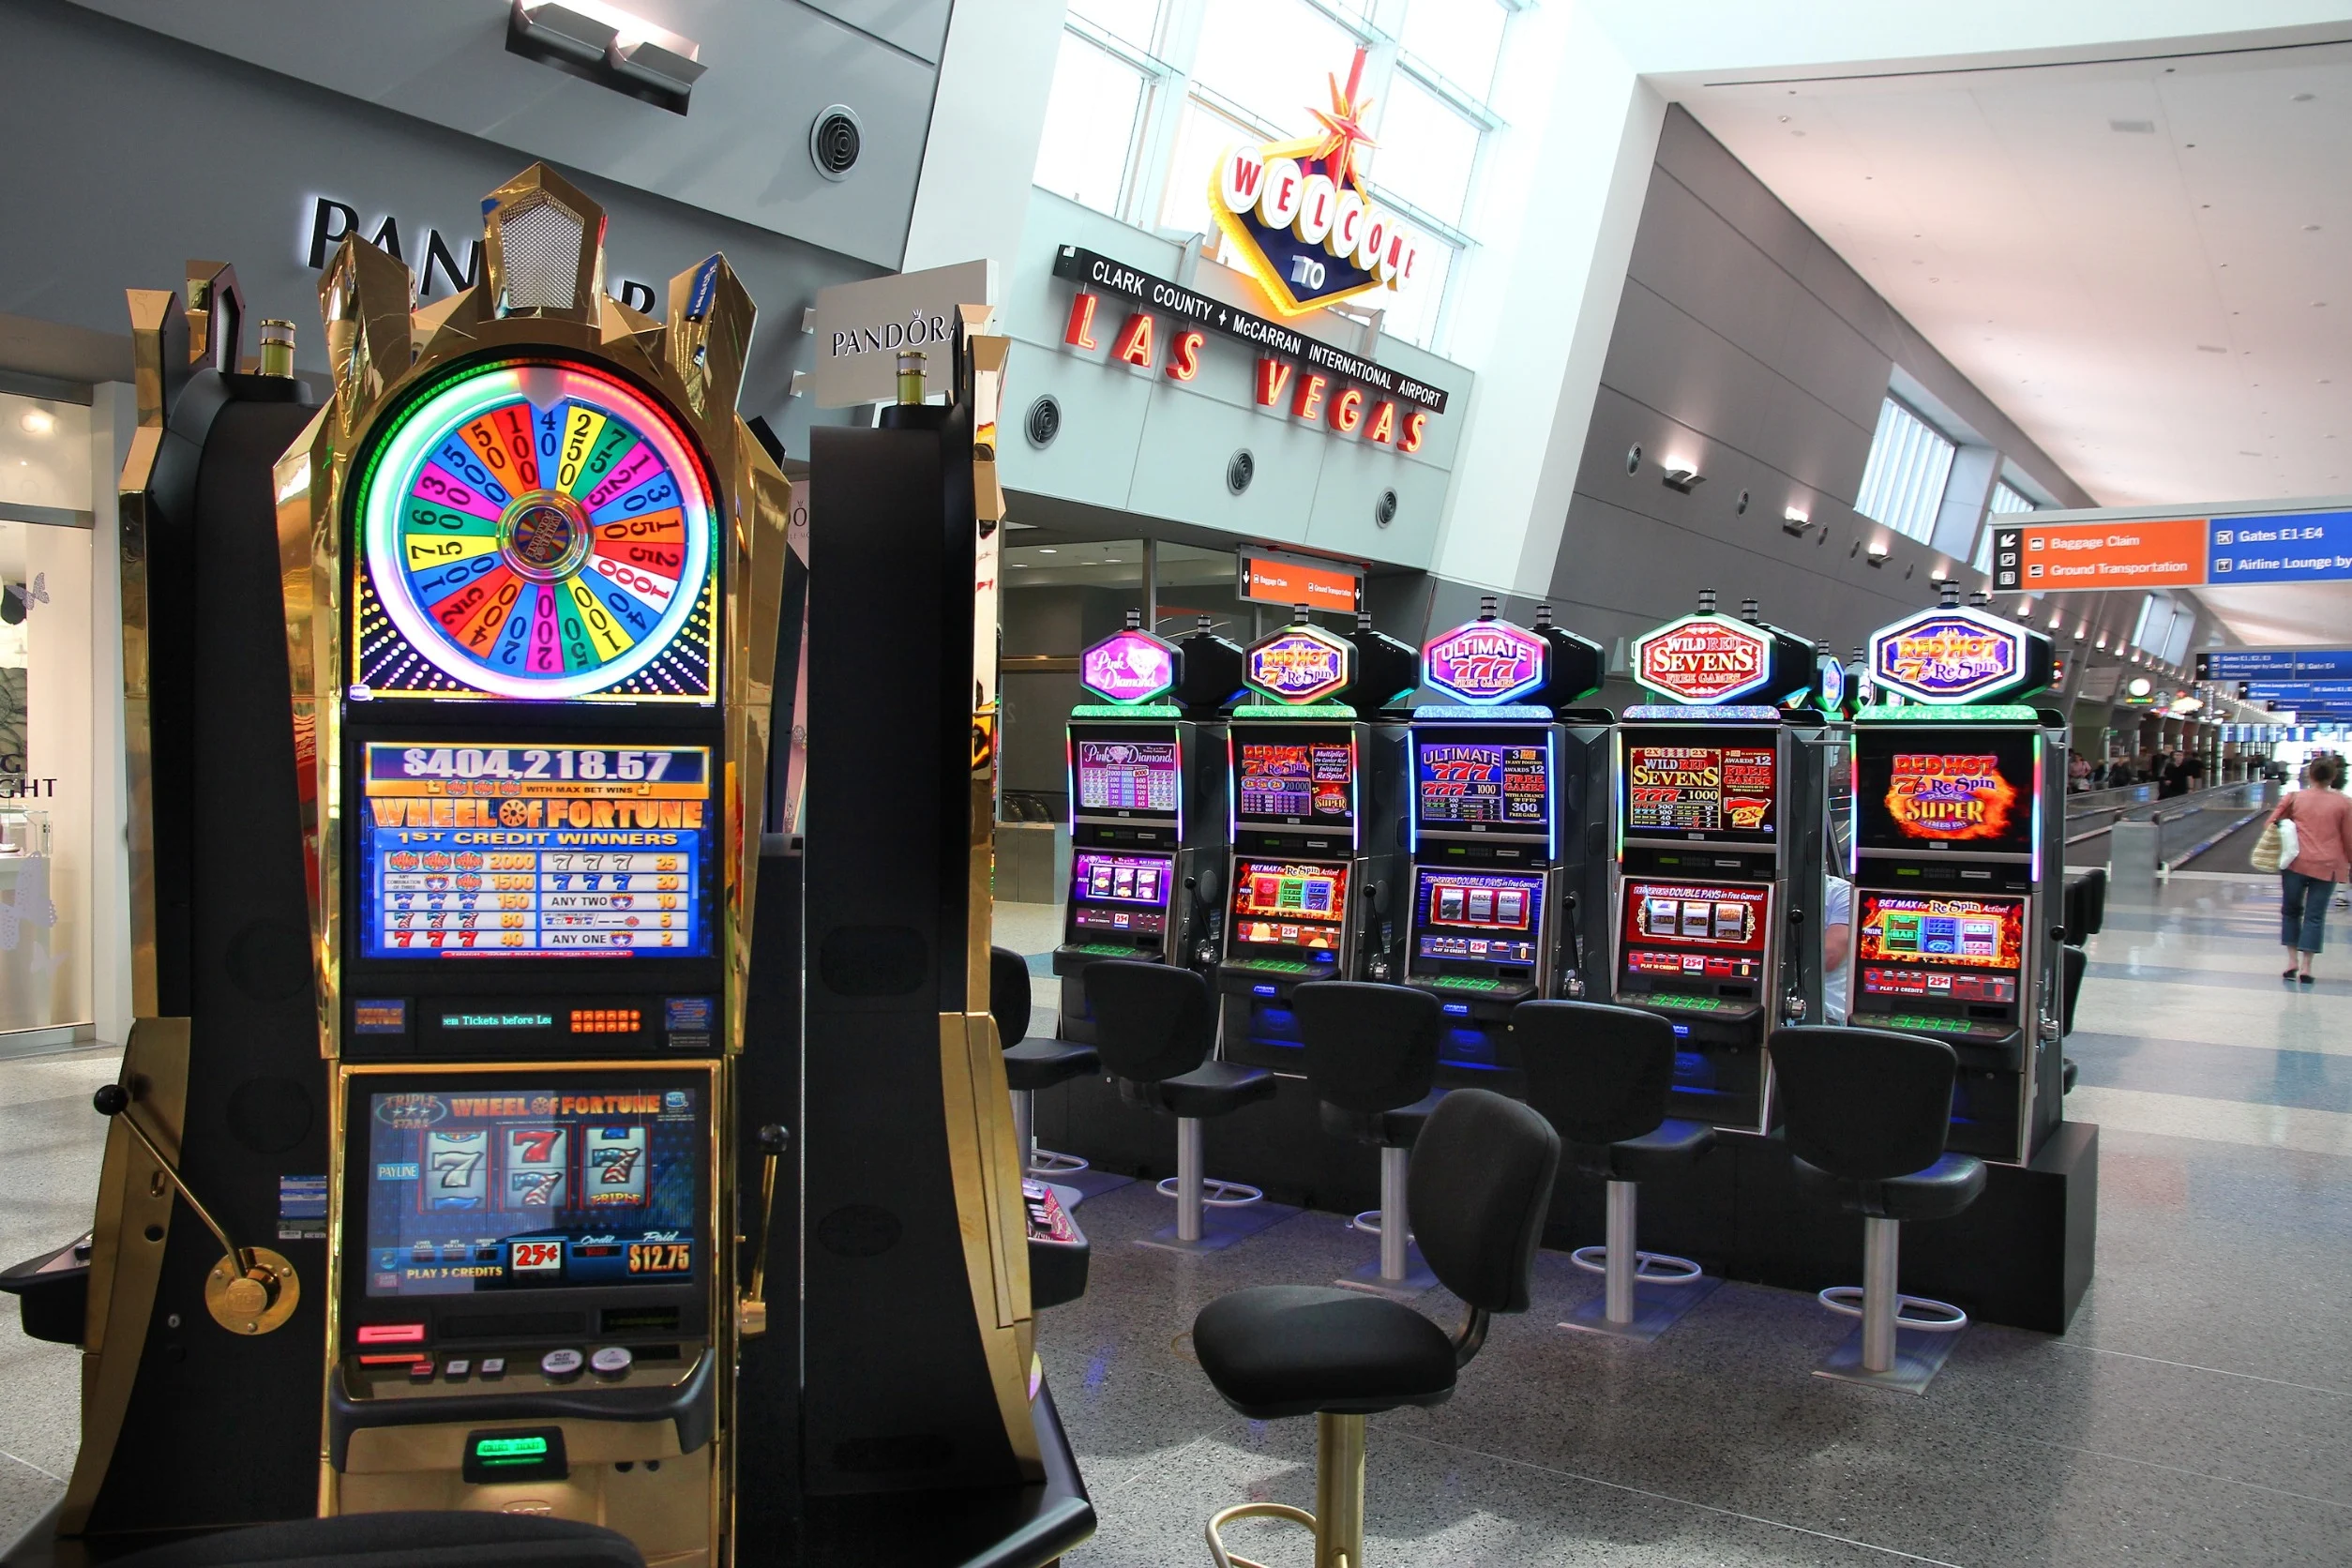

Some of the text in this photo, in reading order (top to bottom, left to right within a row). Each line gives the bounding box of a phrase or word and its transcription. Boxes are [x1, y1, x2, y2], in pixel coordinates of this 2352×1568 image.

[1234, 157, 1415, 279] WELCOME
[1291, 255, 1326, 290] TO
[1093, 261, 1441, 407] CLARK COUNTY McCARRAN INTERNATIONAL AIRPORT
[1066, 294, 1425, 453] LAS VEGAS
[541, 411, 557, 457] 40
[472, 422, 505, 470] 50
[507, 411, 536, 485] 100
[560, 414, 591, 487] 250
[591, 429, 626, 474] 75
[443, 444, 506, 504] 500
[589, 453, 652, 507] 125
[421, 475, 471, 506] 30
[624, 484, 671, 511] 30
[413, 509, 463, 530] 60
[605, 519, 680, 540] 150
[2238, 527, 2324, 542] Gates E1-E4
[411, 541, 462, 560] 75
[2050, 535, 2140, 550] Baggage Claim
[629, 547, 679, 568] 25
[2238, 554, 2352, 571] Airline Lounge by
[421, 556, 494, 593] 100
[2049, 560, 2188, 577] Ground Transportation
[598, 559, 670, 601] 100
[1260, 576, 1276, 587] Baggage
[1314, 584, 1351, 597] Ground Transportation
[441, 586, 485, 626] 25
[609, 592, 647, 631] 40
[469, 583, 518, 647] 400
[575, 586, 621, 652] 100
[503, 616, 526, 665] 20
[537, 594, 554, 670] 200
[565, 617, 588, 669] 50
[1441, 638, 1528, 661] ULTIMATE
[1668, 638, 1740, 652] WILD RED
[1897, 638, 1999, 658] RED HOT
[1093, 649, 1130, 671] Pink
[1263, 650, 1332, 667] RED HOT
[1653, 645, 1754, 672] SEVENS
[1100, 668, 1157, 689] Diamond
[1666, 673, 1741, 684] FREE GAMES
[1084, 744, 1174, 763] Pink Diamond
[1244, 746, 1307, 760] RED HOT
[1424, 747, 1500, 767] ULTIMATE
[1512, 750, 1519, 760] 3
[1755, 756, 1772, 765] 12
[403, 748, 672, 780] $404,218.57
[1530, 765, 1545, 775] 12
[1644, 759, 1709, 770] WILD RED
[1725, 765, 1770, 776] FREE
[1893, 755, 1998, 776] RED HOT
[1504, 774, 1545, 783] FREE
[1633, 765, 1719, 787] SEVENS
[1724, 776, 1771, 785] GAMES
[556, 786, 580, 794] MAX
[584, 786, 602, 794] BET
[1477, 784, 1497, 794] 1000
[1503, 783, 1545, 792] GAMES
[1688, 790, 1718, 800] 1000
[1316, 798, 1347, 808] SUPER
[1512, 803, 1538, 812] 300
[1907, 799, 1985, 822] SUPER
[369, 798, 498, 828] WHEEL
[547, 799, 703, 829] FORTUNE
[398, 832, 679, 846] 1ST CREDIT WINNERS
[490, 853, 535, 870] 2000
[656, 854, 678, 871] 25
[491, 874, 535, 890] 1500
[656, 874, 679, 890] 20
[498, 893, 529, 909] 150
[551, 894, 676, 909] ANY TWO 10
[1669, 888, 1722, 899] DOUBLE PAYS
[1878, 899, 2009, 913] BET MAX Action!
[500, 912, 524, 927] 80
[660, 912, 672, 927] 5
[500, 931, 524, 946] 40
[552, 930, 672, 946] ANY ONE 2
[1685, 958, 1701, 968] 25¢
[1930, 977, 1949, 986] 25¢
[462, 1016, 499, 1026] Tickets
[503, 1016, 534, 1025] before
[450, 1098, 530, 1117] WHEEL
[562, 1094, 660, 1114] FORTUNE
[379, 1166, 417, 1178] PAYLINE
[591, 1193, 641, 1205] TRIPLE
[642, 1231, 679, 1242] Paid
[516, 1244, 558, 1267] 25¢
[629, 1244, 689, 1273] $12.75
[407, 1266, 503, 1279] PLAY 3 CREDITS
